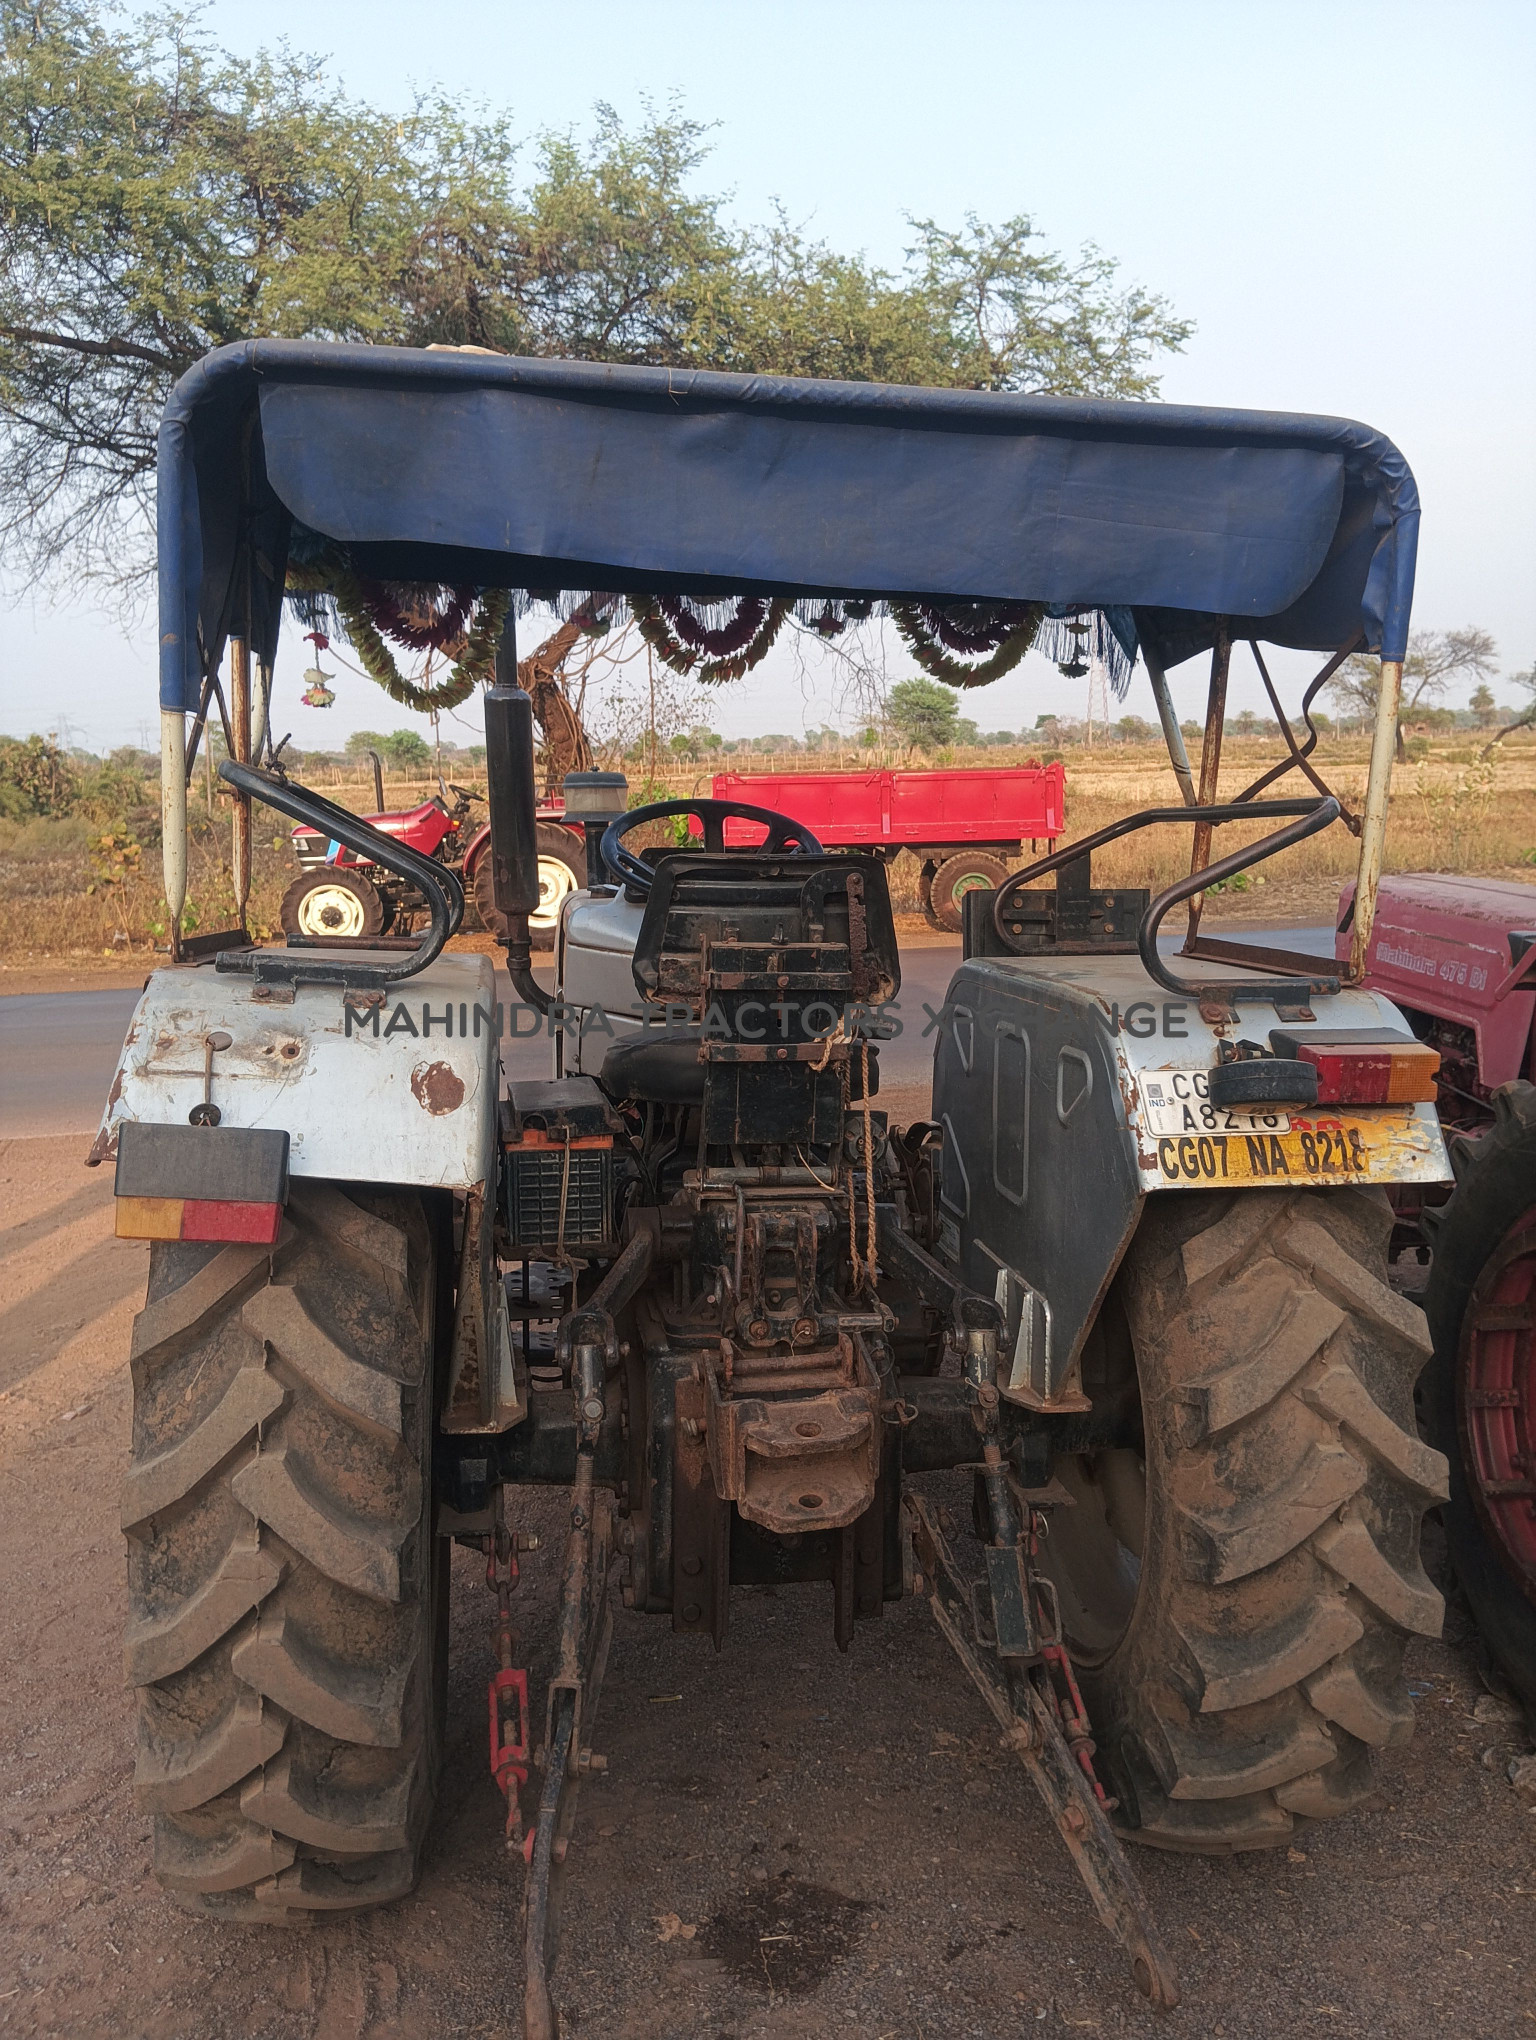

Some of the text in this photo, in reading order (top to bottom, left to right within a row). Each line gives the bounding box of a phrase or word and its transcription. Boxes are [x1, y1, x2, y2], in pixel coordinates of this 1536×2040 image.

[1376, 942, 1437, 977] Mahindra
[1440, 960, 1468, 985] 475
[1158, 1127, 1364, 1179] CG07 NA 8218
